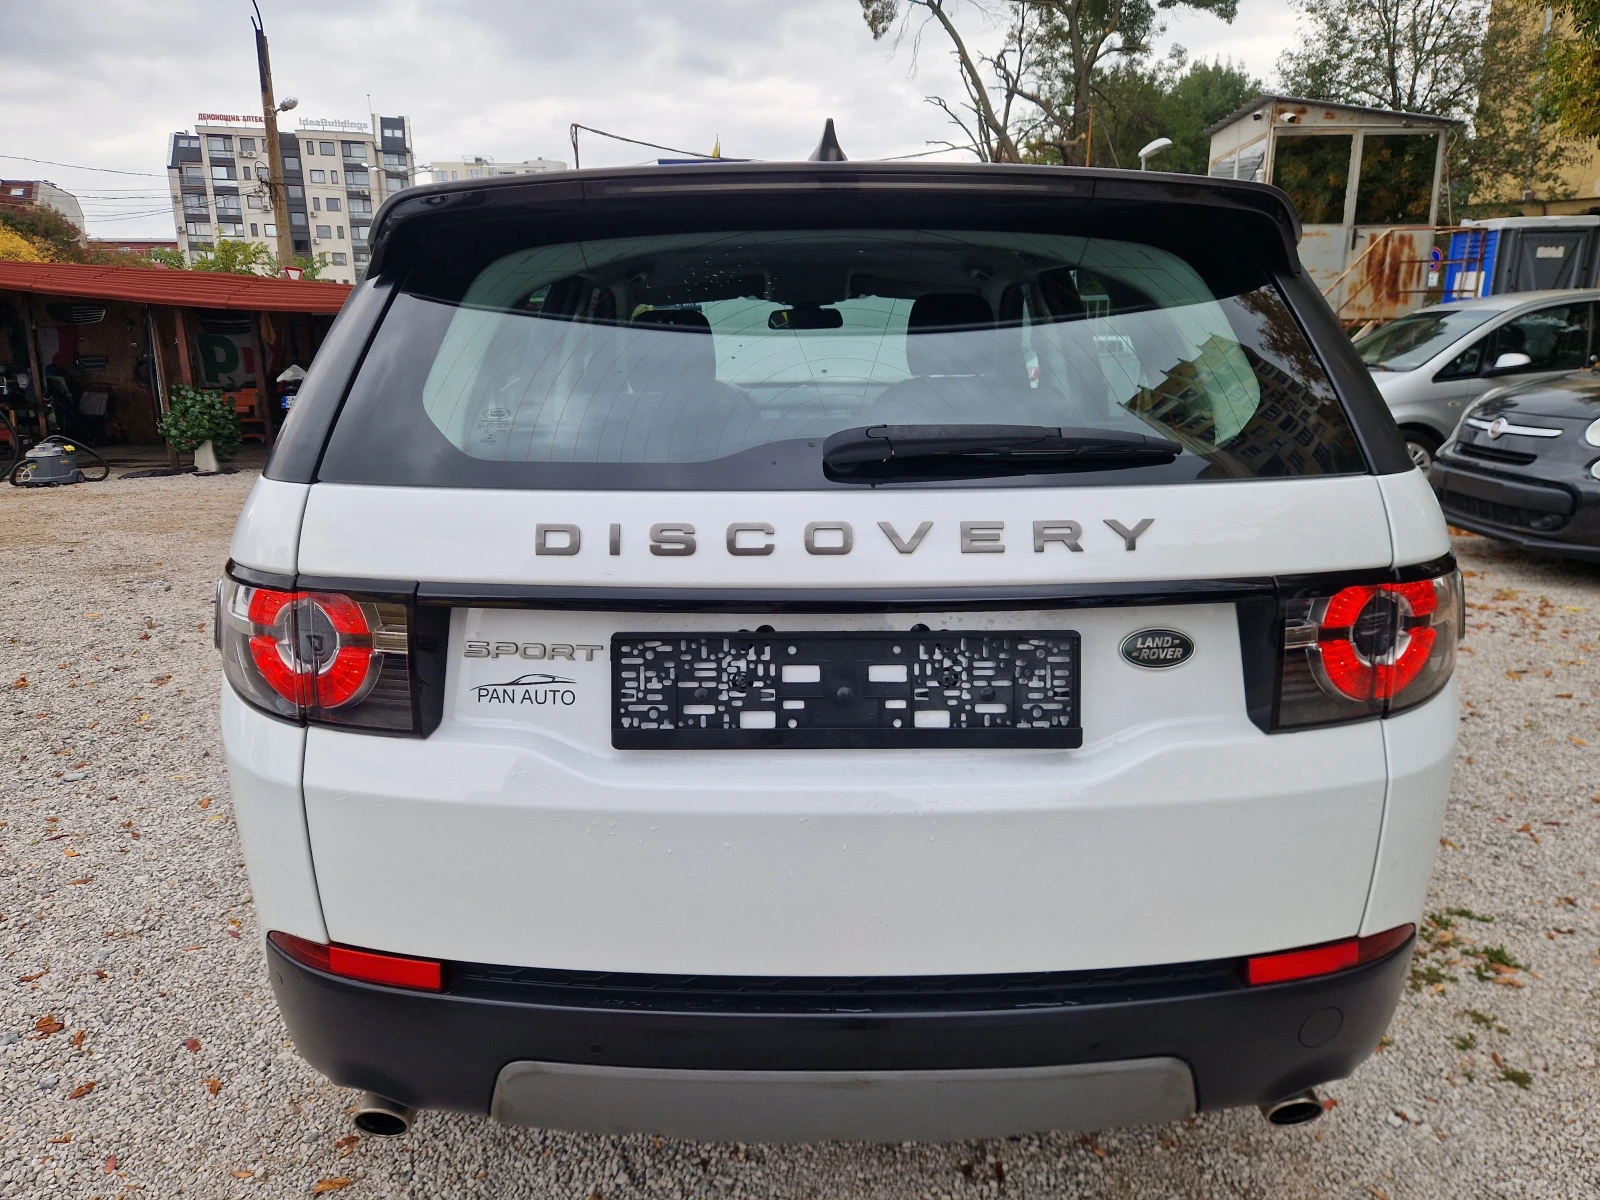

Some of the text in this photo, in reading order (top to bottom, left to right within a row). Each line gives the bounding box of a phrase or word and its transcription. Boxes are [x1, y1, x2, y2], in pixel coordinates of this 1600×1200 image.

[198, 112, 264, 123] ДЕНОНОЩНА АПТЕК
[535, 518, 1155, 556] DISCOVERY
[1136, 636, 1172, 648] LAND
[464, 640, 604, 661] SPORT
[1140, 648, 1183, 660] ROVER
[477, 687, 576, 705] PAN AUTO
